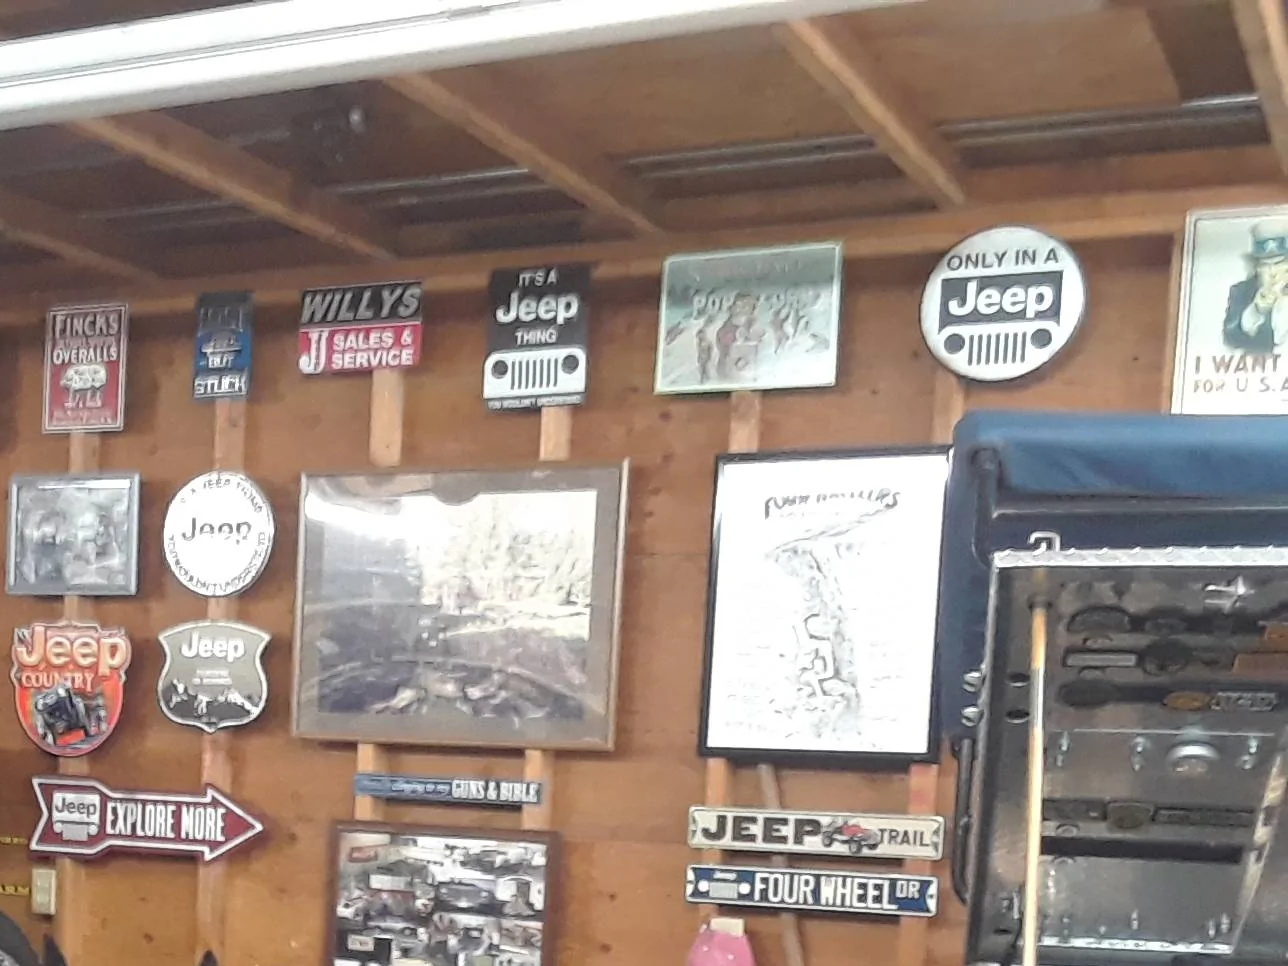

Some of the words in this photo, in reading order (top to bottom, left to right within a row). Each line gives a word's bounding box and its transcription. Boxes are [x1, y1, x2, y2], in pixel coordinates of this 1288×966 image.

[947, 250, 1007, 271] ONLY
[1015, 249, 1036, 266] IN
[1043, 247, 1060, 264] A
[547, 267, 558, 284] A
[301, 284, 421, 323] WILLYS
[495, 291, 579, 325] Jeep
[948, 280, 1054, 318] Jeep
[333, 329, 394, 350] SALES
[400, 327, 413, 346] &
[514, 327, 558, 345] THING
[52, 346, 118, 365] OVERALLS
[331, 349, 414, 369] SERVICE
[1195, 356, 1201, 374] I
[1212, 353, 1282, 374] WANT
[194, 372, 247, 395] STUCK
[181, 517, 253, 545] Jeep
[15, 626, 129, 677] Jeep
[181, 631, 245, 662] Jeep
[21, 671, 96, 691] COUNTRY
[452, 780, 486, 799] GUNS
[486, 780, 498, 801] &
[499, 782, 539, 803] BIBLE
[55, 799, 97, 817] Jeep
[105, 801, 176, 839] EXPLORE
[180, 807, 227, 841] MORE
[701, 814, 822, 846] JEEP
[877, 828, 930, 848] TRAIL
[754, 873, 816, 904] FOUR
[819, 875, 898, 909] WHEEL
[896, 880, 920, 899] DR
